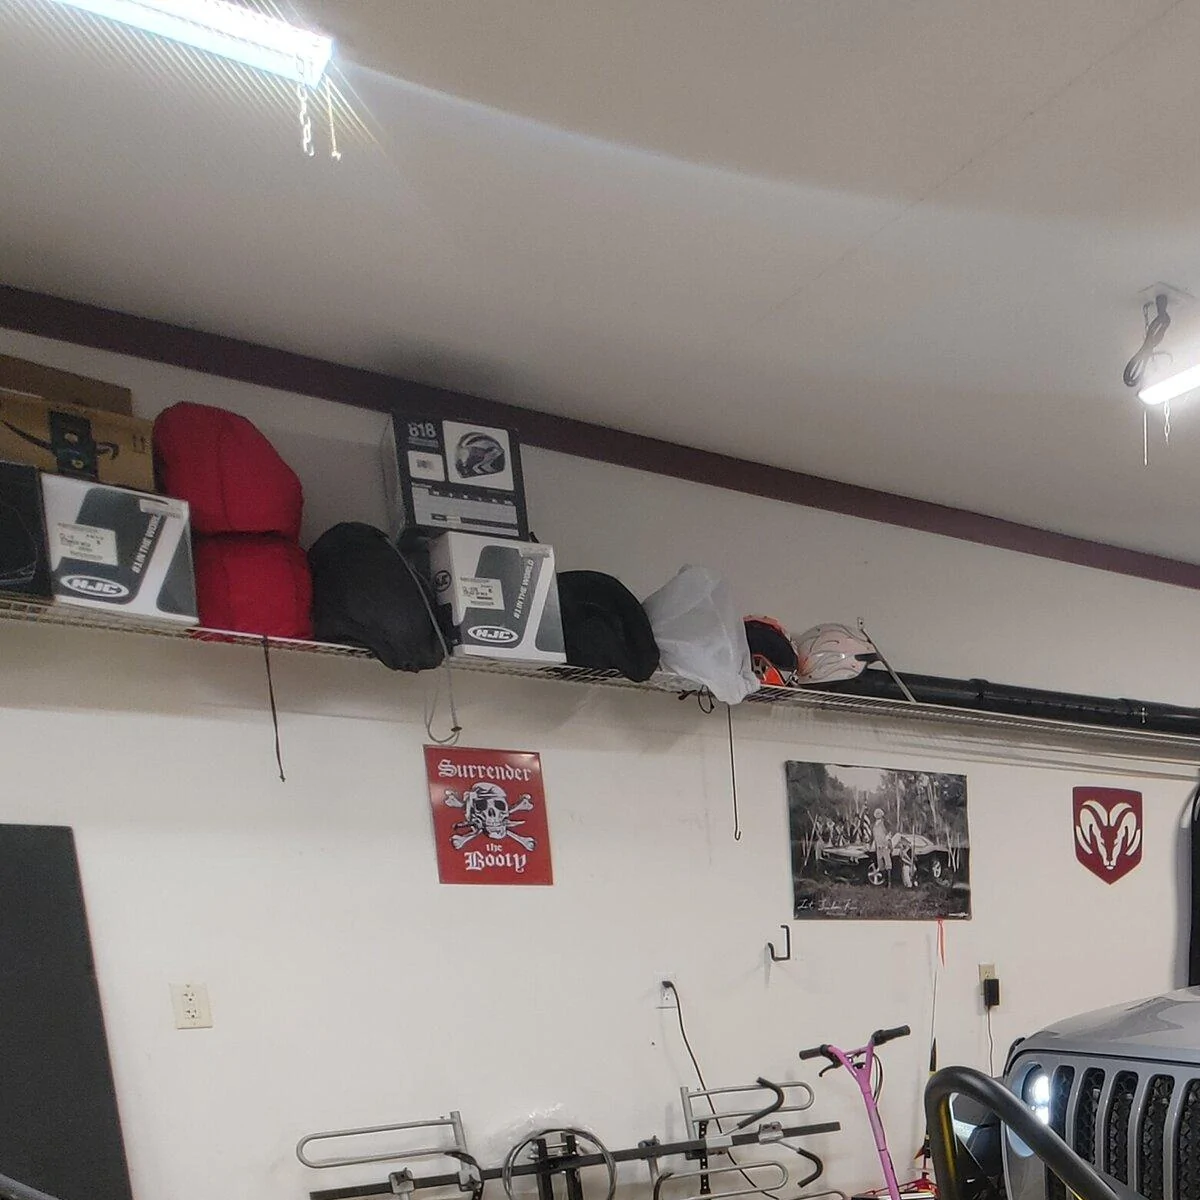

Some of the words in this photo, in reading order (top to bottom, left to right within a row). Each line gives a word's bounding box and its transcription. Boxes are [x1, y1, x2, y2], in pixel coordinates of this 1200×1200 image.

[70, 579, 118, 594] HJC
[476, 629, 511, 639] HJC
[438, 759, 532, 781] Surrender
[486, 843, 502, 852] the
[464, 851, 527, 873] Booty
